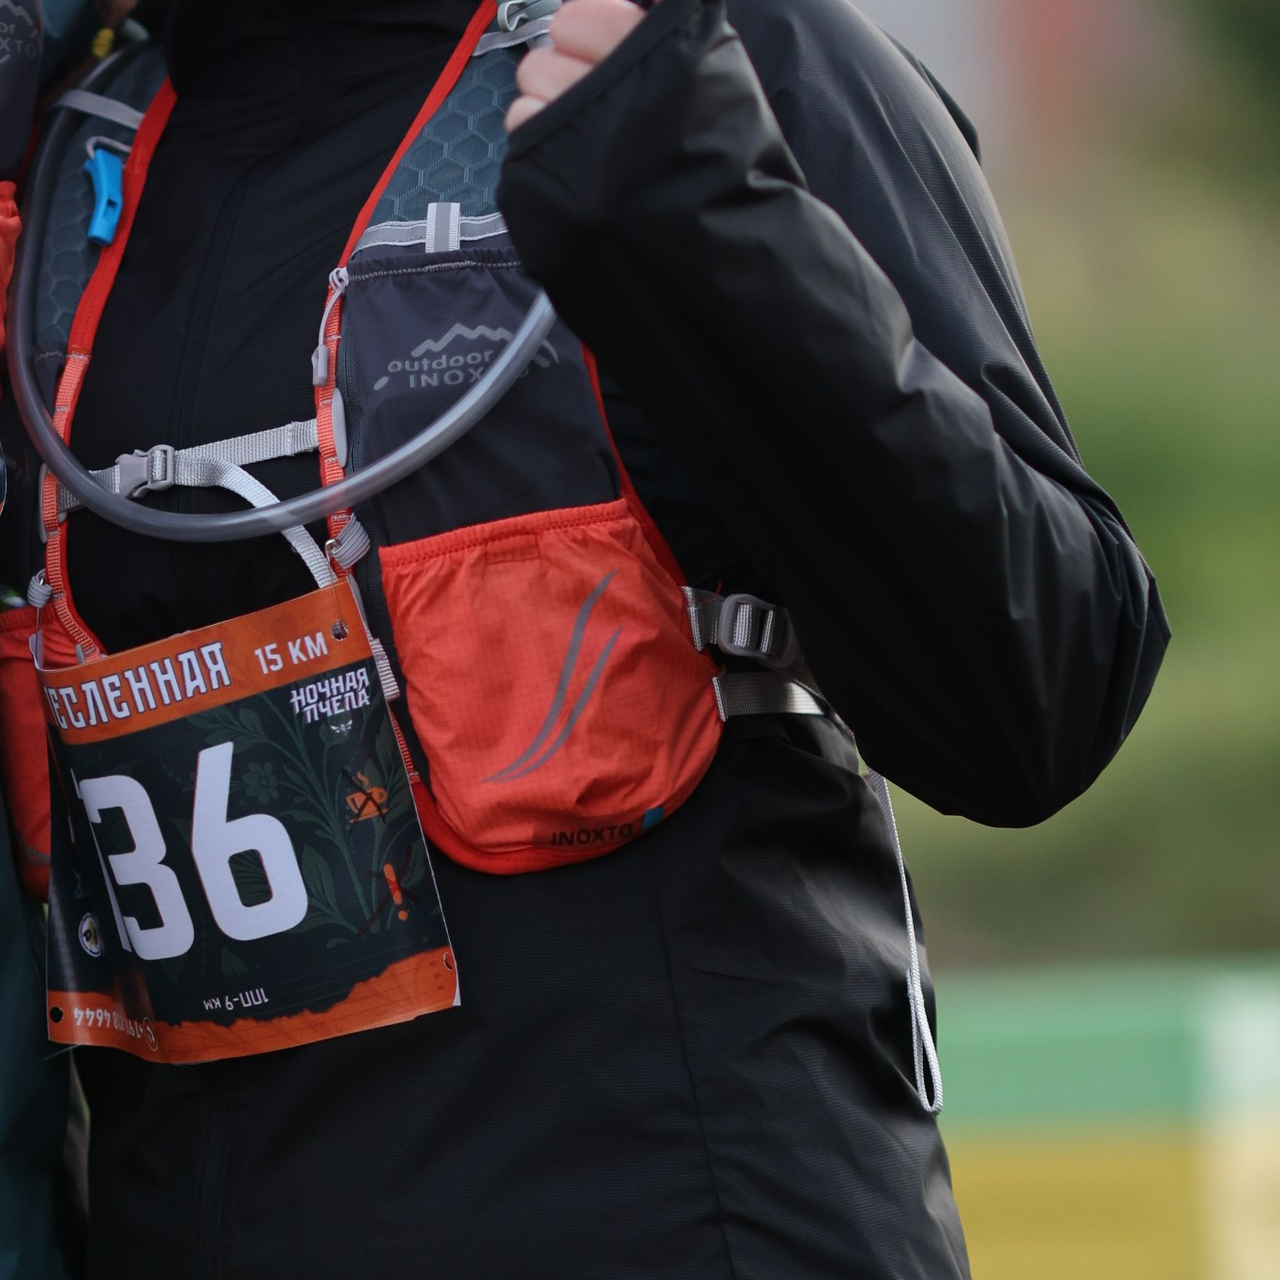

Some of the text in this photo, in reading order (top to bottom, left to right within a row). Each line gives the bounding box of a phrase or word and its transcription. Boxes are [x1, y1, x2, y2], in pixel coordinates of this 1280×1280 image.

[387, 349, 494, 373] outdoor
[254, 643, 283, 674] 15
[290, 667, 370, 714] НОЧНАЯ
[302, 687, 371, 724] ПЧЕЛА
[551, 823, 633, 846] INOXTO
[203, 997, 221, 1011] км
[73, 1007, 111, 1028] 4644
